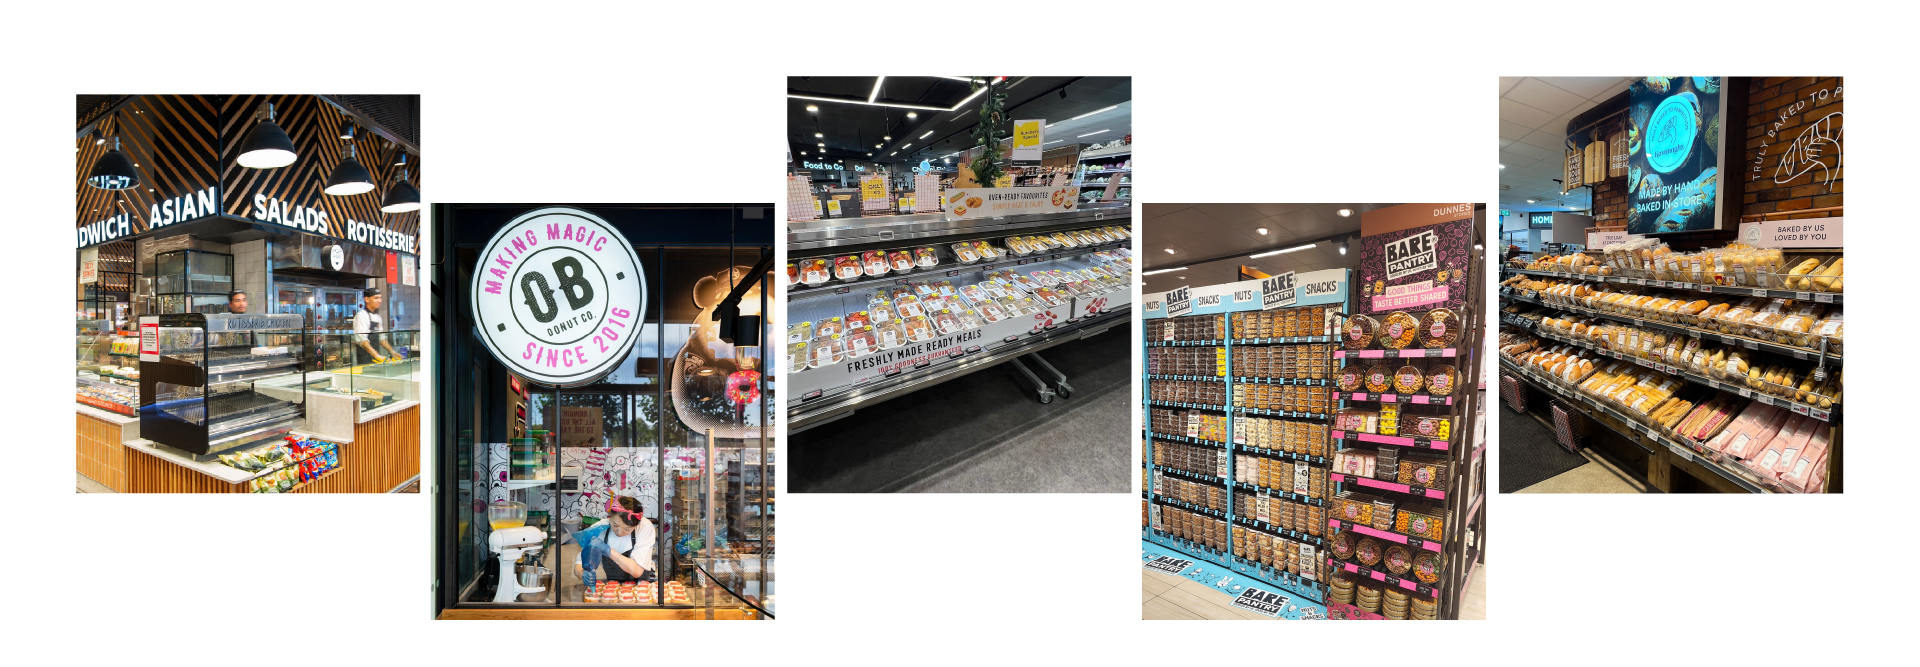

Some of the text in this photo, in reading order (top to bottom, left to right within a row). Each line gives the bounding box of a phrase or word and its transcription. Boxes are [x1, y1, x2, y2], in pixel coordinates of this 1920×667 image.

[1752, 86, 1844, 181] TRULY BAKED TO P
[803, 161, 824, 170] Food
[1020, 191, 1049, 200] FAVOURITES
[1639, 179, 1700, 200] MADE BY HAND
[149, 186, 217, 230] ASIAN
[992, 201, 1011, 210] SIMPLY
[1433, 203, 1472, 217] DUNNES
[1636, 194, 1702, 213] BAKED IN-STORE
[254, 193, 328, 235] SALADS
[76, 212, 130, 249] DWICH
[347, 218, 415, 254] ROTISSERIE
[546, 223, 607, 252] MAGIC
[1774, 234, 1798, 242] LOVED
[1810, 233, 1827, 241] YOU
[1777, 225, 1802, 233] BAKED
[1814, 224, 1825, 232] US
[1386, 231, 1433, 264] BARE
[485, 229, 538, 295] MAKING
[1389, 252, 1432, 273] PANTRY
[1262, 272, 1295, 296] BARE
[1306, 281, 1337, 295] SNACKS
[1387, 282, 1431, 296] GOOD THINGS
[1165, 287, 1189, 306] BARE
[1198, 294, 1220, 306] SNACKS
[1234, 290, 1252, 301] NUTS
[1264, 288, 1295, 305] PANTRY
[1374, 291, 1447, 309] TASTE BETTER SHARED
[1146, 300, 1160, 311] NUTS
[1167, 300, 1190, 315] PANTRY
[227, 317, 292, 330] ROTISSERIE CHICKEN
[547, 310, 597, 337] DONUT CO.
[522, 307, 631, 368] SINCE 2016
[847, 329, 983, 373] FRESHLY MADE READY MEALS
[1156, 555, 1193, 568] BARE
[1235, 597, 1280, 613] PANTRY
[1241, 587, 1290, 608] BARE
